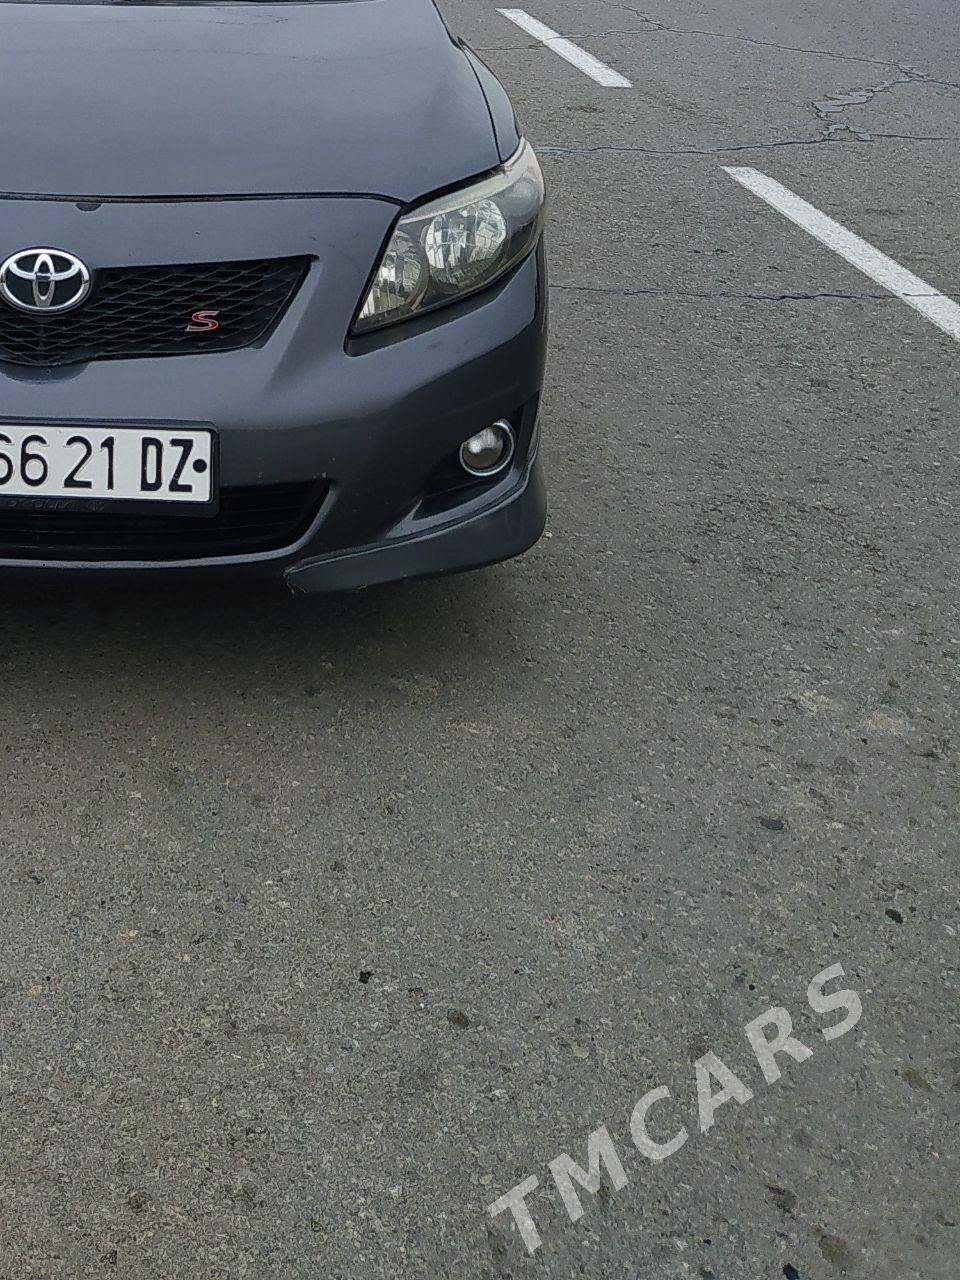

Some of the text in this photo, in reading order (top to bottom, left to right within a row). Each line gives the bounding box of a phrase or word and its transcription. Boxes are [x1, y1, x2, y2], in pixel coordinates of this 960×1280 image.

[185, 310, 220, 331] S
[63, 435, 115, 491] 21
[140, 436, 194, 493] DZ
